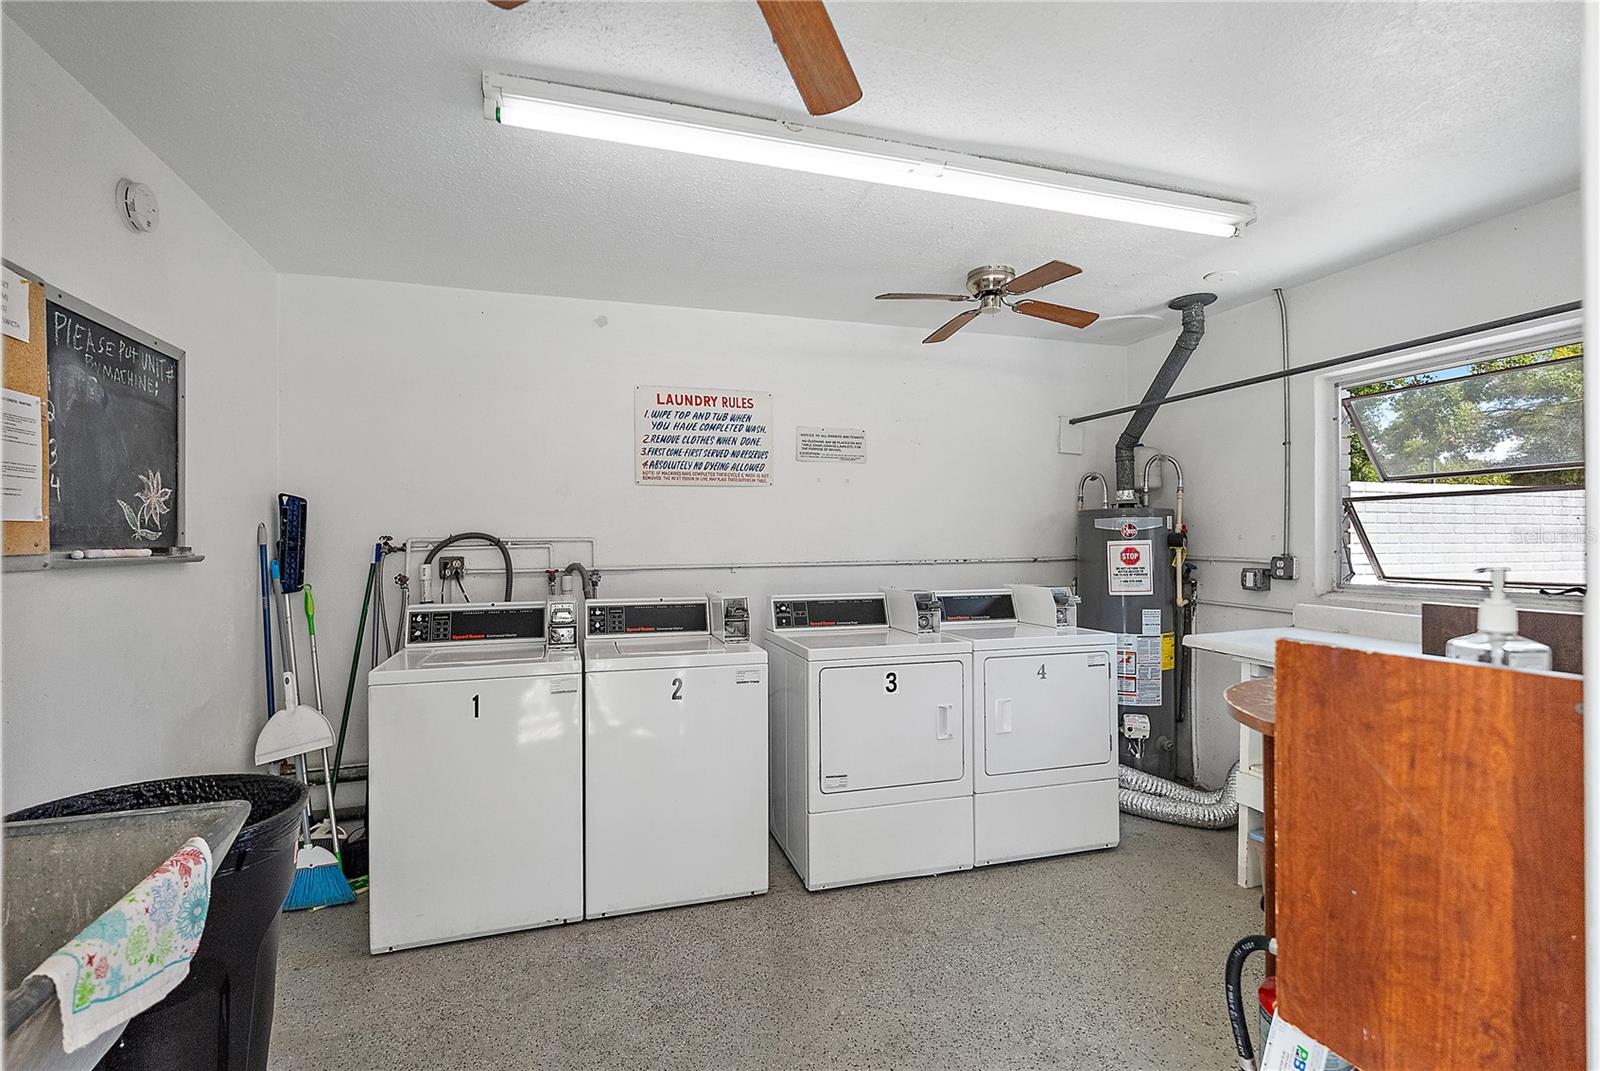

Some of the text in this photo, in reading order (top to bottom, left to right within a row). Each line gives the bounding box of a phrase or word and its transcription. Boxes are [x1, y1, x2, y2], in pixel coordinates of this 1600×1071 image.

[141, 352, 167, 382] UNIT
[656, 393, 754, 409] LAUNDRY RULES
[650, 410, 672, 419] WIPE
[674, 411, 691, 420] TOP
[692, 412, 711, 421] AND
[712, 412, 729, 422] TUB
[729, 414, 752, 423] WHEN
[651, 421, 671, 431] YOU
[673, 422, 698, 431] HAVE
[699, 422, 745, 433] COMPLETED
[650, 434, 681, 444] REMOVE
[681, 435, 715, 445] CLOTHES
[716, 436, 738, 446] WHEN
[647, 447, 667, 457] FIRST
[740, 450, 769, 460] RESERVES
[648, 460, 692, 470] ABSOLUTELY
[693, 461, 703, 470] NO
[703, 461, 730, 472] DYEING
[730, 462, 766, 473] ALLOWED
[50, 473, 61, 502] 4
[1121, 552, 1139, 560] STOP
[1037, 664, 1047, 680] 4
[671, 677, 683, 700] 2
[885, 672, 898, 693] 3
[472, 694, 480, 719] 1
